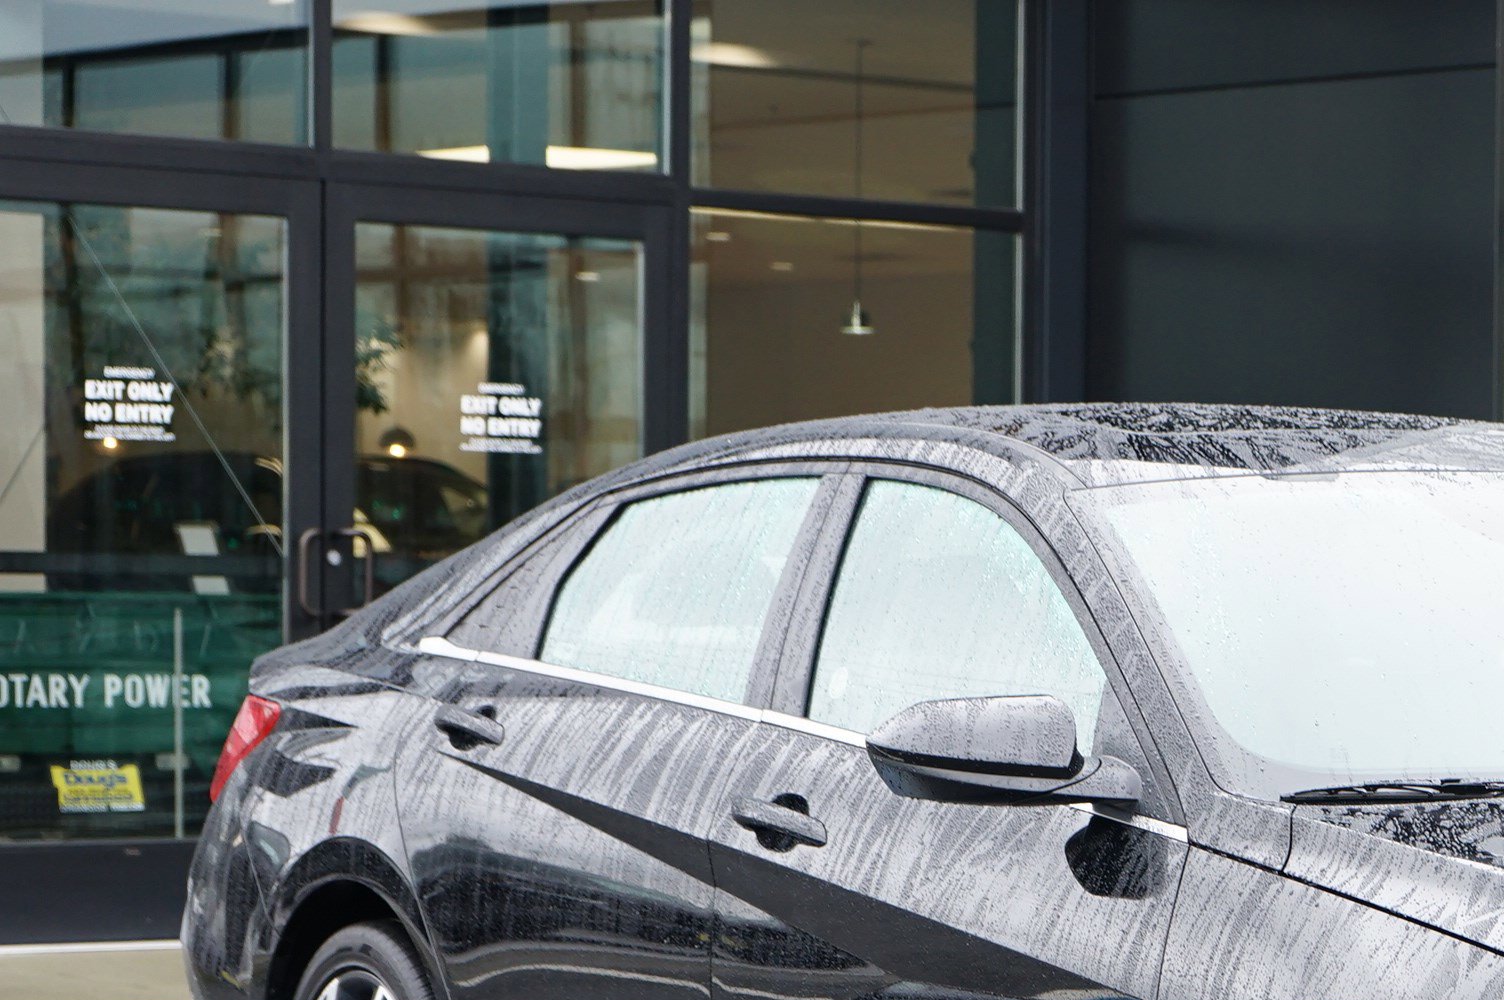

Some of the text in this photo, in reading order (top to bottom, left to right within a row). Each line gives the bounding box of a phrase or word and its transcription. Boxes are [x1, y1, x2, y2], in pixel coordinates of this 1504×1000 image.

[84, 379, 175, 402] EXIT ONLY
[84, 401, 174, 424] NO ENTRY
[103, 673, 212, 708] POWER
